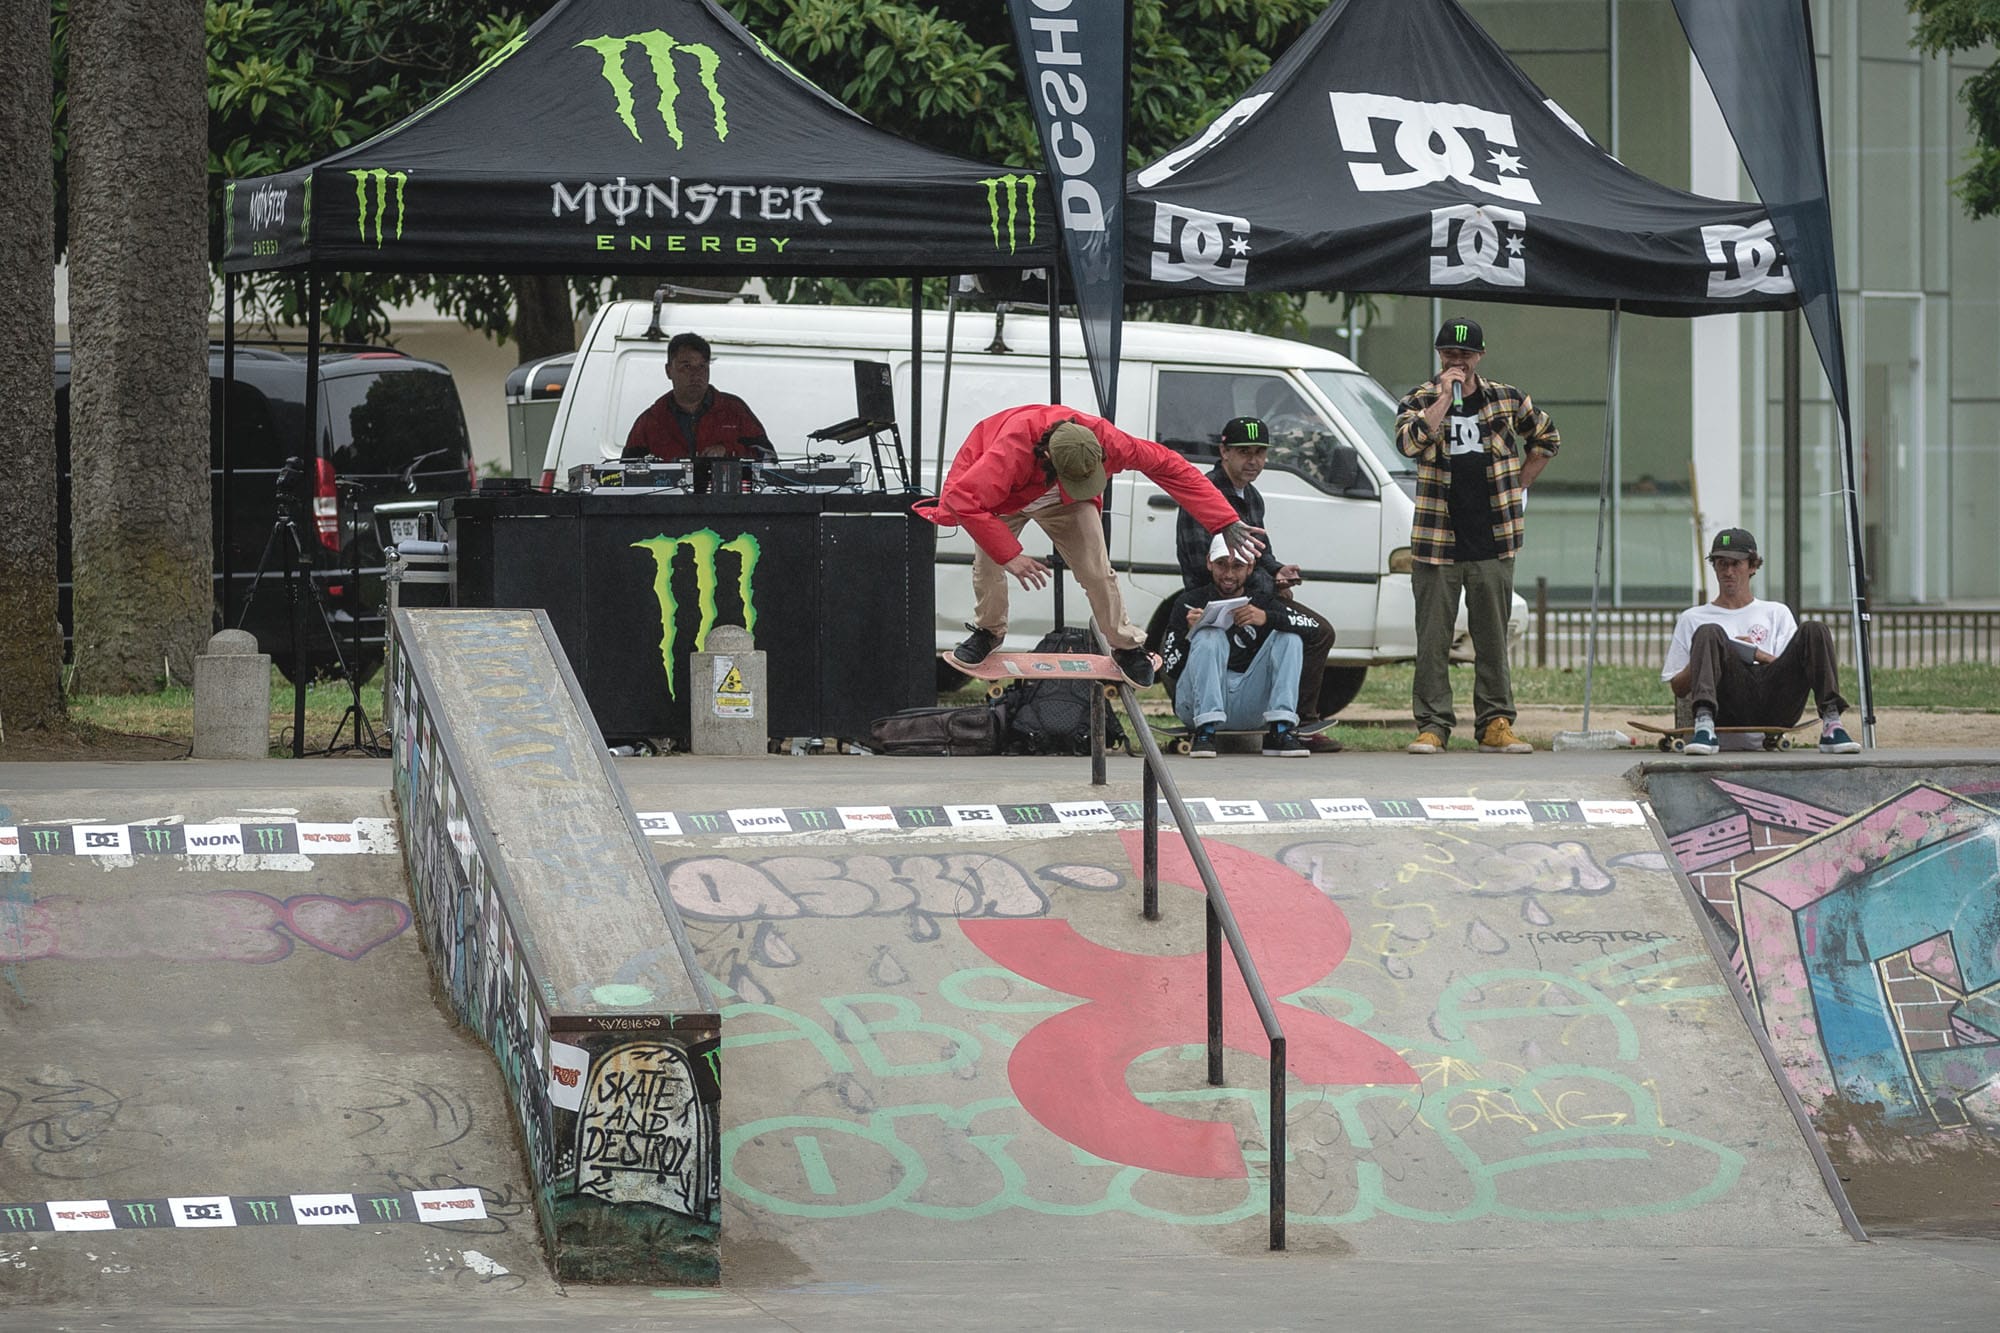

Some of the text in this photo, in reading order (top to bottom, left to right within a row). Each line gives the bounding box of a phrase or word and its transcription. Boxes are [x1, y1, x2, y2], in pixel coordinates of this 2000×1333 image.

[596, 234, 792, 254] ENERGY
[1060, 807, 1108, 819] WOM
[1320, 804, 1368, 814] WOM
[736, 815, 786, 828] WOM
[190, 835, 240, 848] WOM
[598, 1068, 683, 1111] SKATE
[604, 1107, 668, 1133] AND
[583, 1126, 691, 1172] DESTROY
[299, 1205, 355, 1217] WOM
